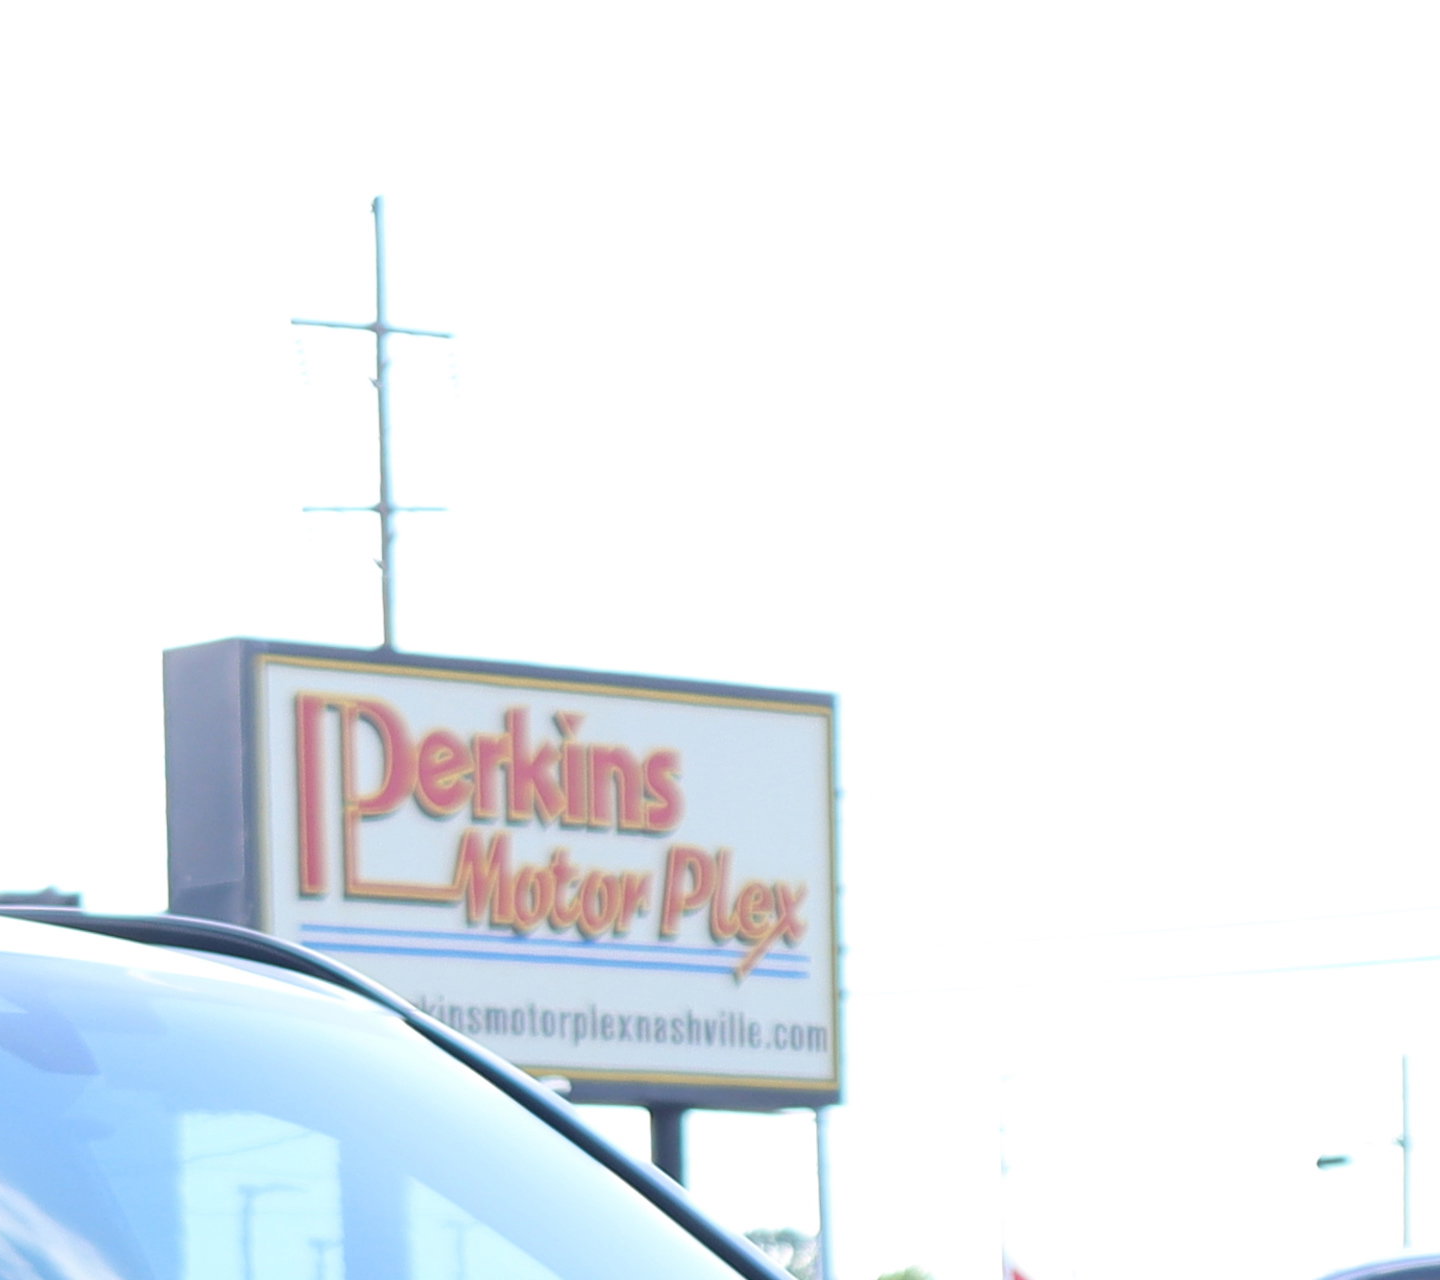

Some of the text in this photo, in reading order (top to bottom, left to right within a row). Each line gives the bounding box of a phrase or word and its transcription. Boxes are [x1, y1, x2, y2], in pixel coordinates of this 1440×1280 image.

[294, 692, 683, 898] Perkins
[453, 828, 810, 979] Motor Plex
[413, 994, 829, 1053] kinsmotorplexnashville.com
